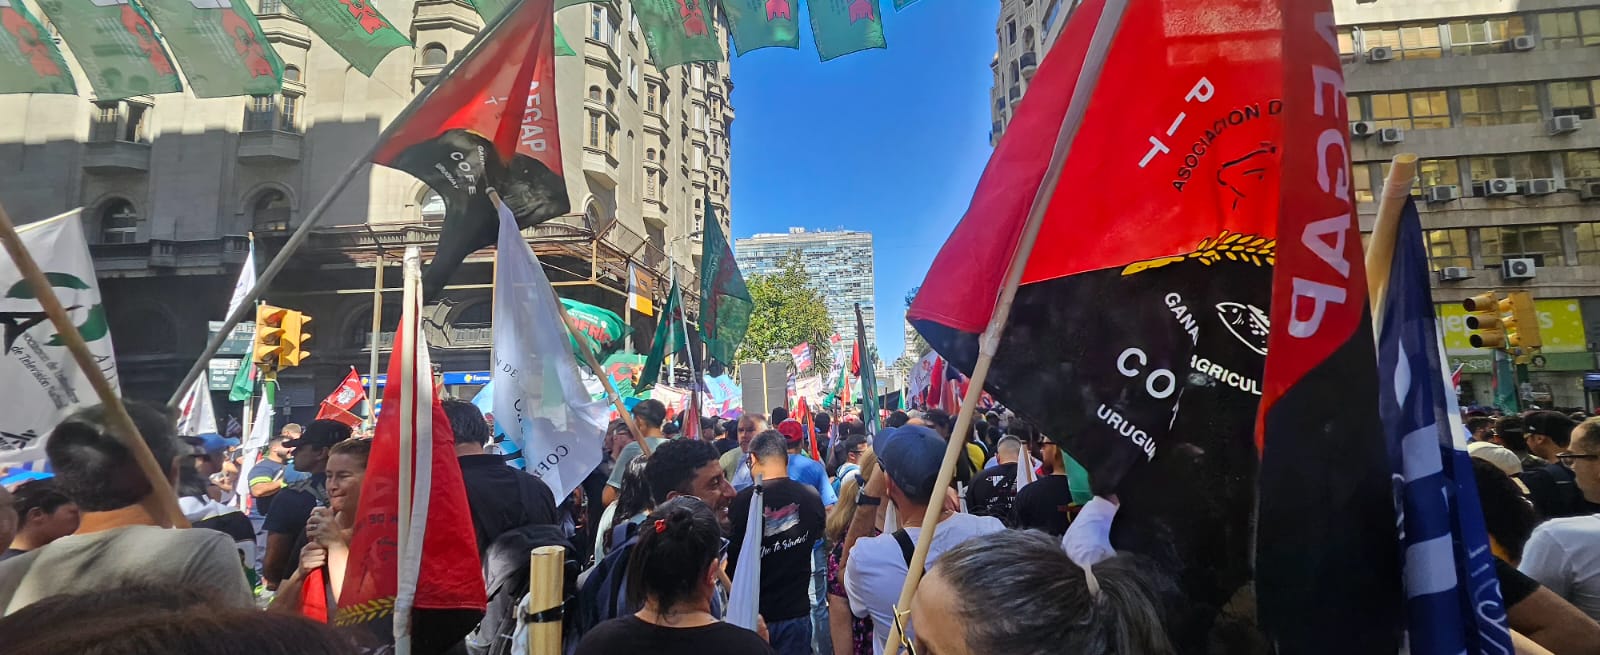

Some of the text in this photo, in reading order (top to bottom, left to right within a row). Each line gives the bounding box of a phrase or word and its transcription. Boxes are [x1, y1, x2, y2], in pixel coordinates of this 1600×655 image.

[450, 151, 476, 196] COFE
[1171, 103, 1261, 193] ASOCIACION
[1096, 403, 1156, 462] URUGU
